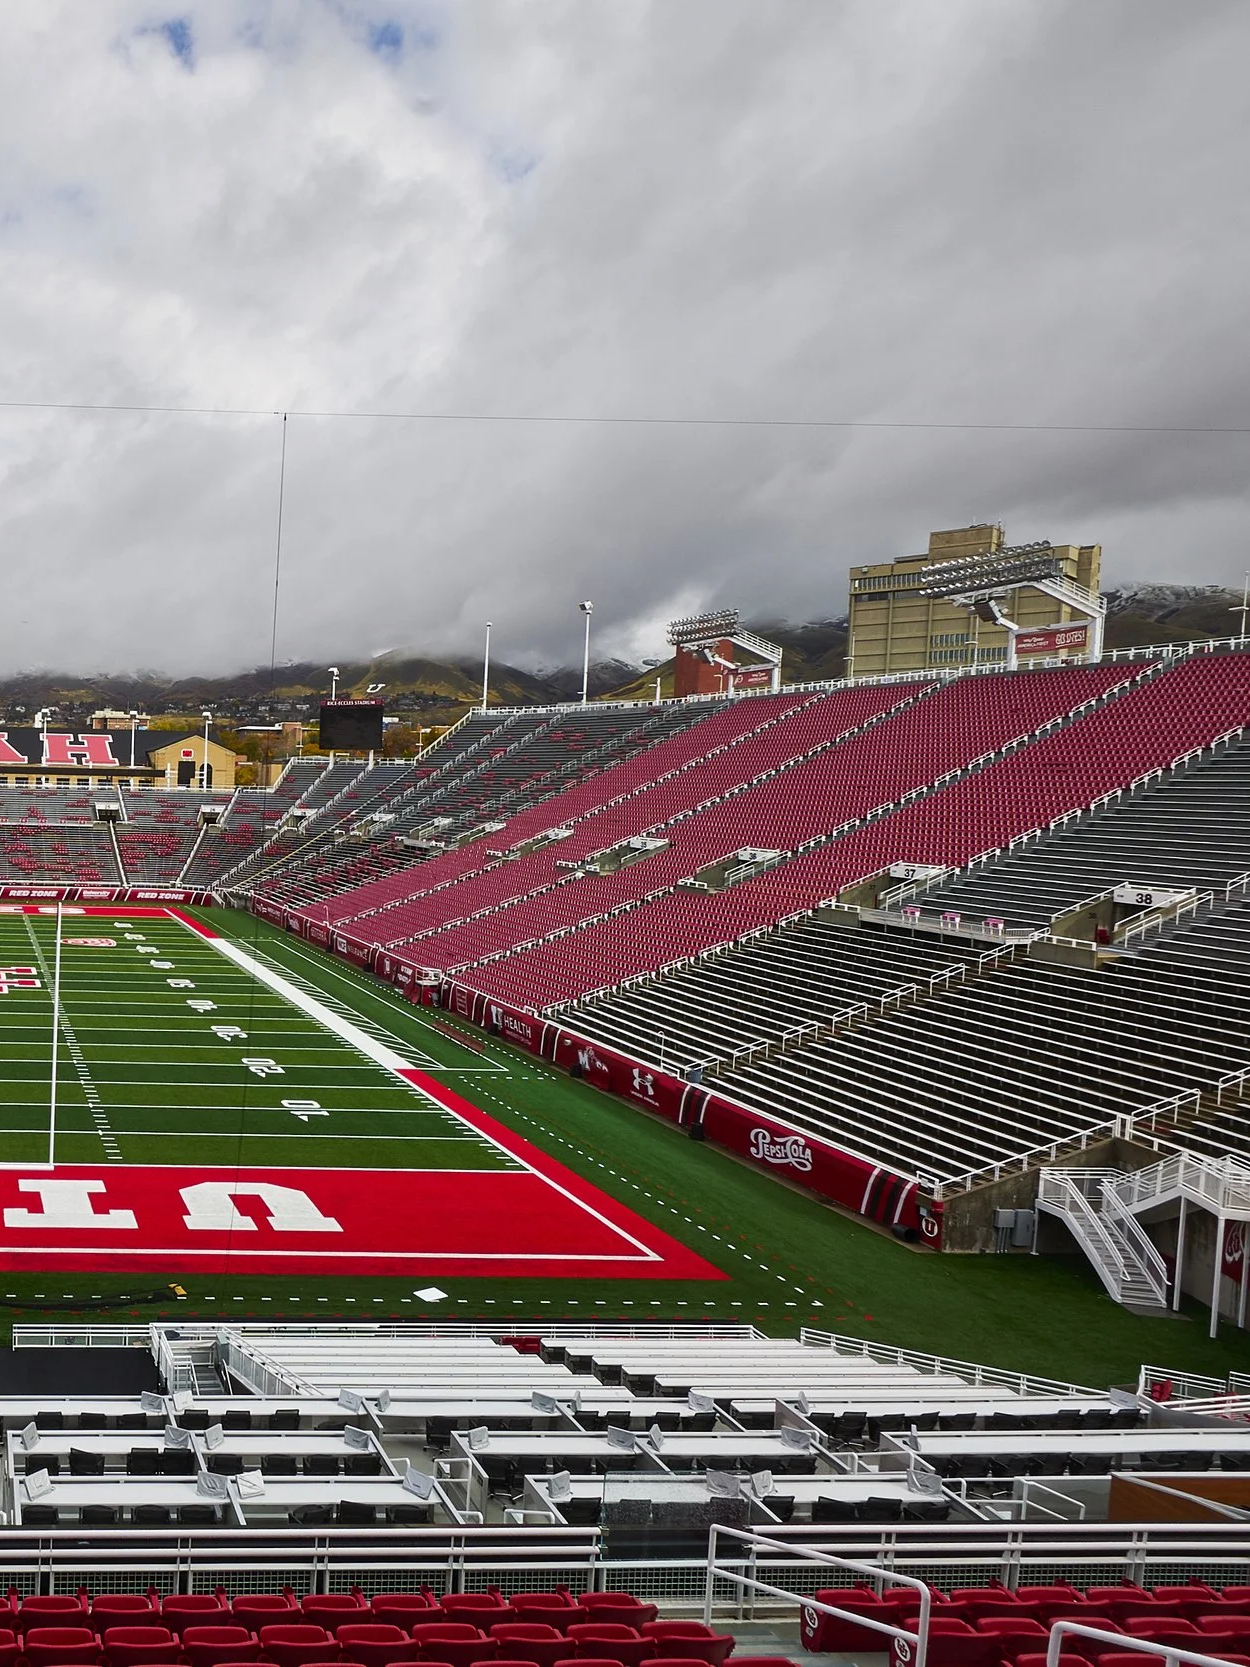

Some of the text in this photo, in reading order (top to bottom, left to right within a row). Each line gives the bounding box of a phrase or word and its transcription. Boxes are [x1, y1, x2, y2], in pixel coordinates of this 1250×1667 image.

[366, 684, 386, 694] U
[904, 868, 916, 878] 37
[8, 889, 59, 898] RED ZONE
[136, 891, 158, 899] RED
[1135, 893, 1153, 904] 38
[210, 1025, 248, 1038] 30
[503, 1014, 532, 1039] HEALTH
[241, 1057, 286, 1074] 20
[280, 1099, 330, 1116] 10
